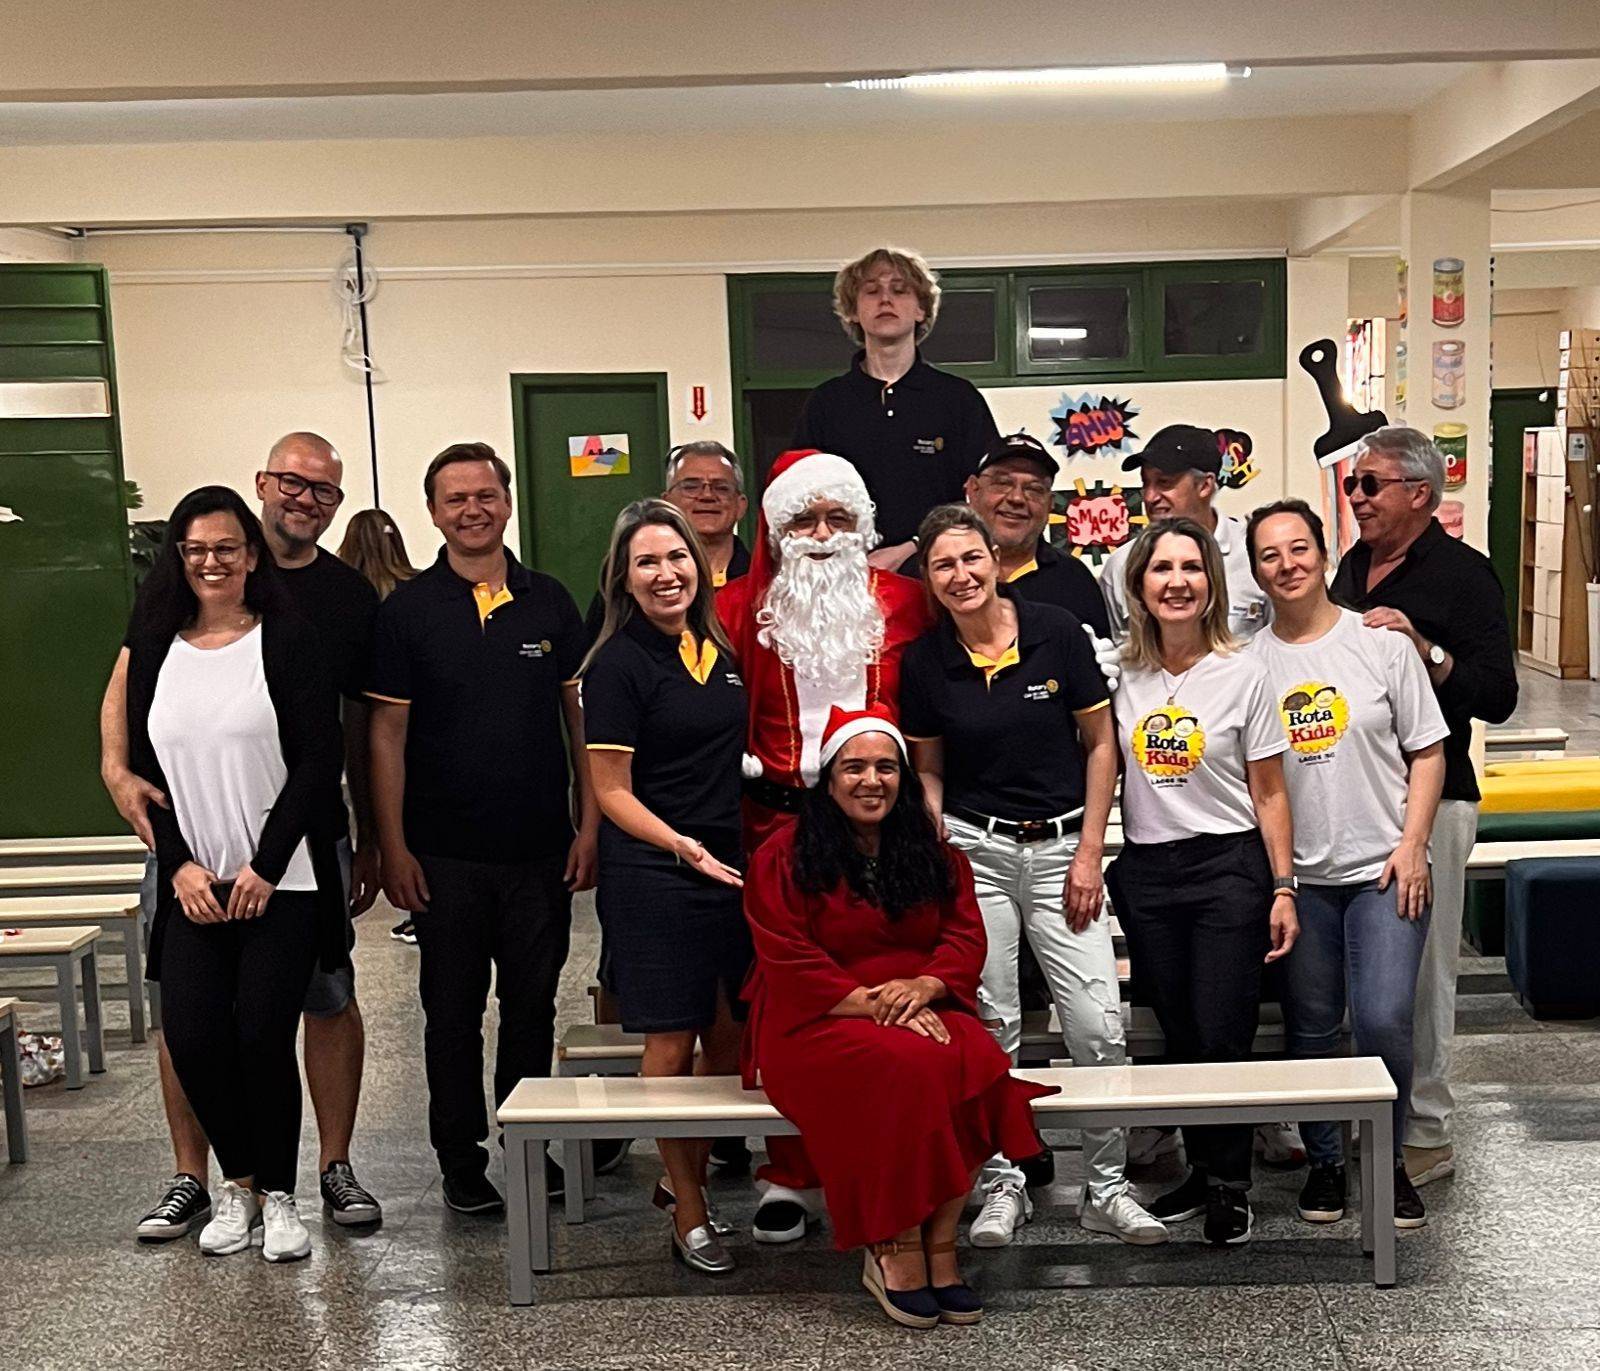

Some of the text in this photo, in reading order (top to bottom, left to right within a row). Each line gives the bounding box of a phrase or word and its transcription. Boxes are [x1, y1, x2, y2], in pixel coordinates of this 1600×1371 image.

[1069, 505, 1125, 537] SMACK!
[1289, 709, 1334, 726] Rota
[1145, 734, 1189, 751] Rota
[1289, 725, 1336, 743] Kids
[1145, 750, 1189, 767] Kids
